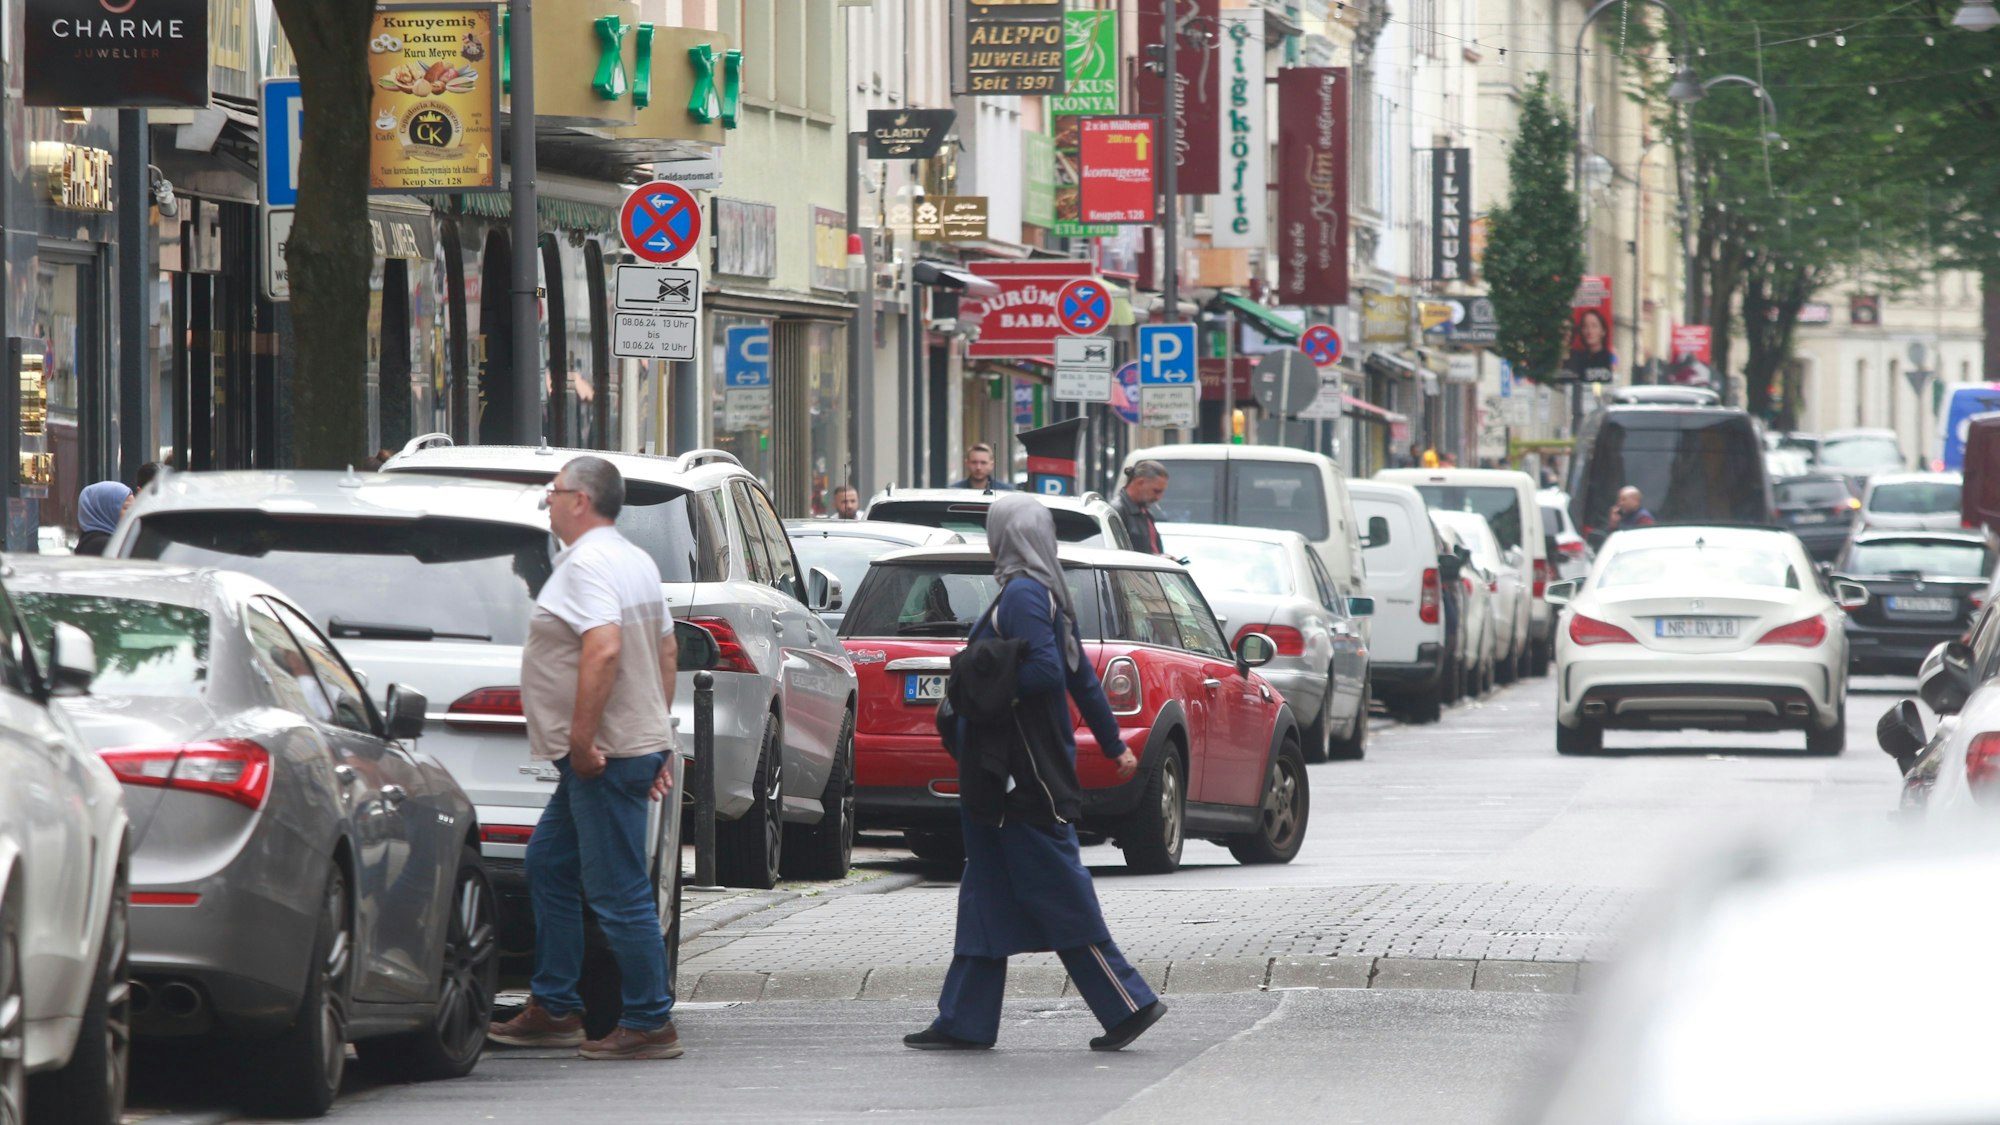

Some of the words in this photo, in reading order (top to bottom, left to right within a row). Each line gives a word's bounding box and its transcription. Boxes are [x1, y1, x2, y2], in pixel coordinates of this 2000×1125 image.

[52, 18, 184, 38] CHARME
[383, 16, 476, 29] Kuruyemiş
[403, 33, 457, 43] Lokum
[970, 26, 1061, 44] ALEPPO
[74, 48, 160, 58] JUWELIER
[404, 48, 426, 58] Kuru
[428, 48, 457, 59] Meyve
[972, 76, 1009, 90] Seit
[1053, 97, 1115, 110] KONYA
[1085, 121, 1091, 131] 2
[875, 128, 930, 138] CLARITY
[657, 172, 714, 181] Geldautomat
[1083, 165, 1149, 179] komagene
[428, 177, 444, 185] Str.
[447, 177, 462, 185] 128
[980, 285, 1059, 317] URÜM
[622, 317, 656, 327] 08.06.24
[663, 319, 671, 328] 13
[673, 320, 689, 328] Uhr
[1001, 313, 1060, 328] BABA
[647, 331, 660, 339] bis
[622, 341, 655, 350] 10.06.24
[661, 343, 669, 351] 12
[671, 343, 687, 351] Uhr
